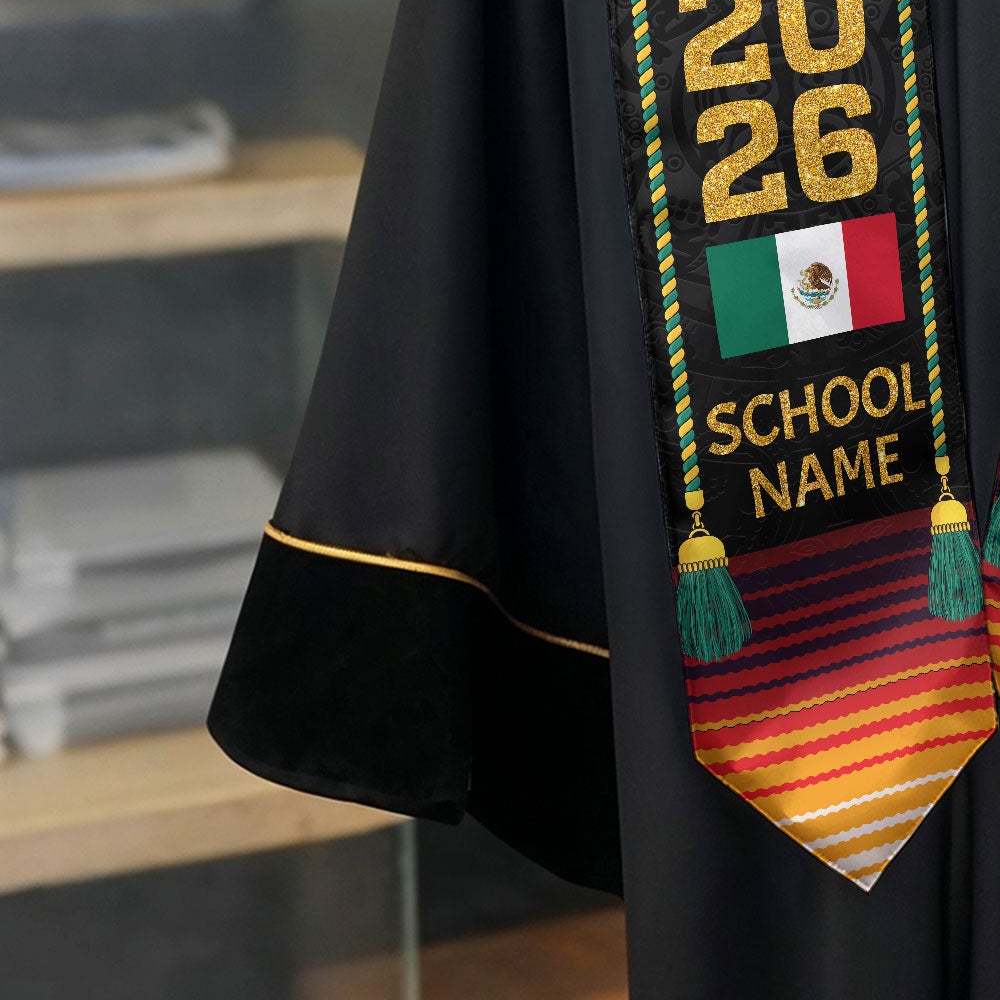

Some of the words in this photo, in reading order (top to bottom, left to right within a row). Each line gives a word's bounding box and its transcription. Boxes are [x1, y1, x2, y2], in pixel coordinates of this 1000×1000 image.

[695, 82, 879, 224] 26
[706, 361, 926, 456] SCHOOL
[748, 432, 904, 519] NAME
